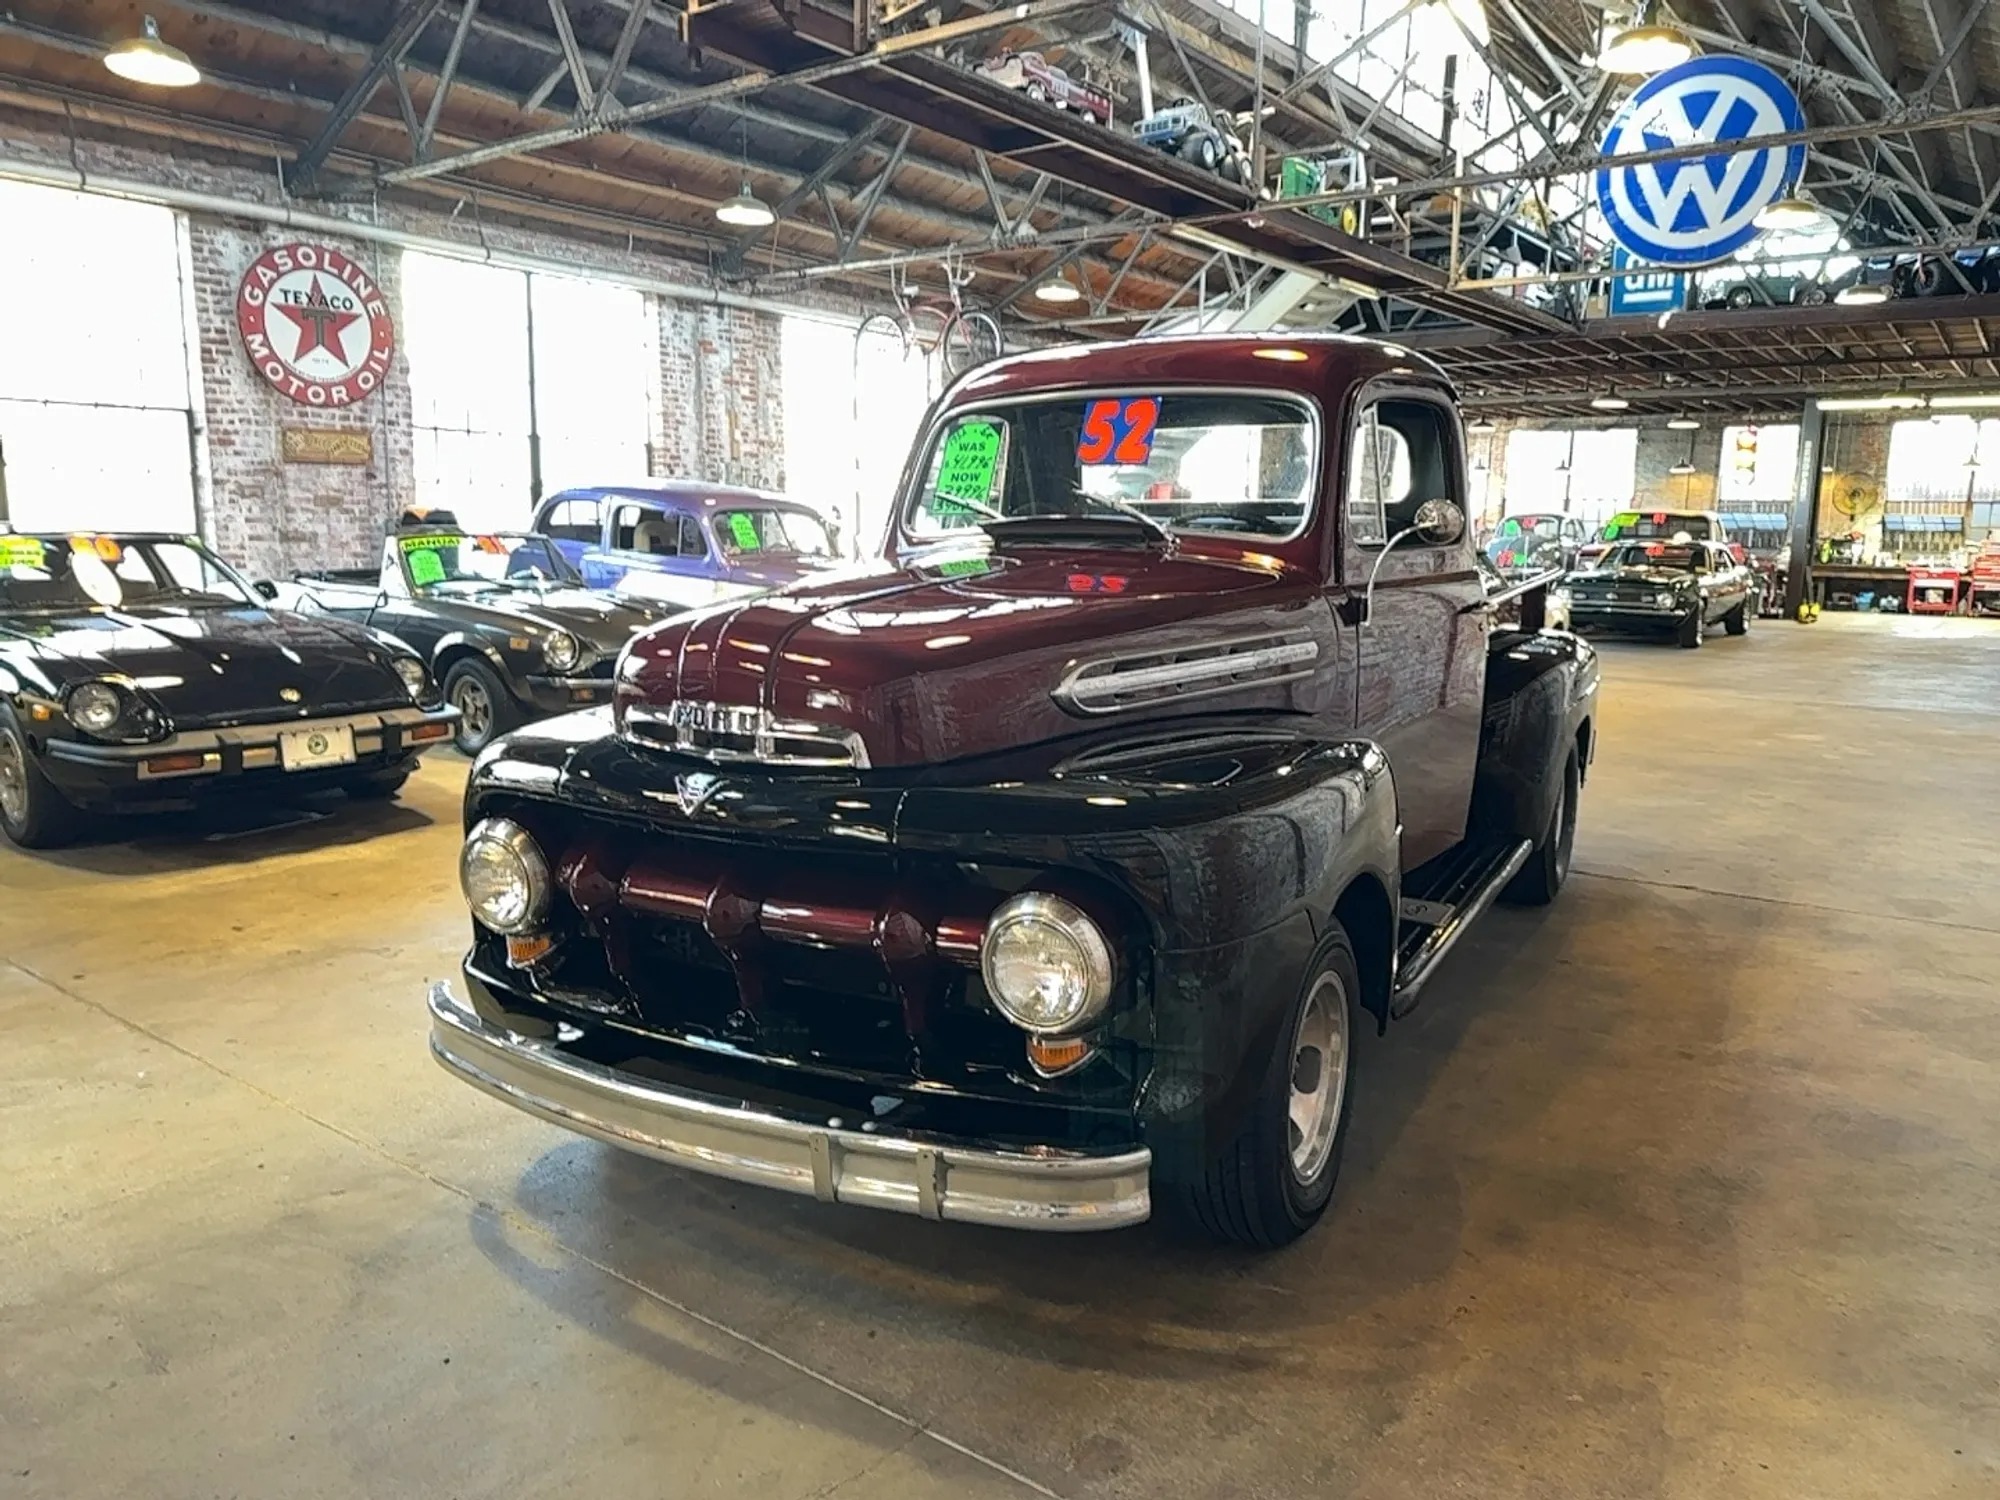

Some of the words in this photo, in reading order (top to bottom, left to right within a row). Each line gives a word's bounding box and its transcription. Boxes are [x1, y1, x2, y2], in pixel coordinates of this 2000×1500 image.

[1614, 78, 1784, 246] VW
[244, 246, 386, 318] GASOLINE
[1624, 254, 1676, 291] GM
[279, 288, 354, 311] TEXACO
[246, 333, 350, 404] MOTOR
[357, 346, 389, 390] OIL
[959, 442, 986, 452] WAS
[1077, 398, 1158, 465] 52
[951, 472, 981, 482] NOW
